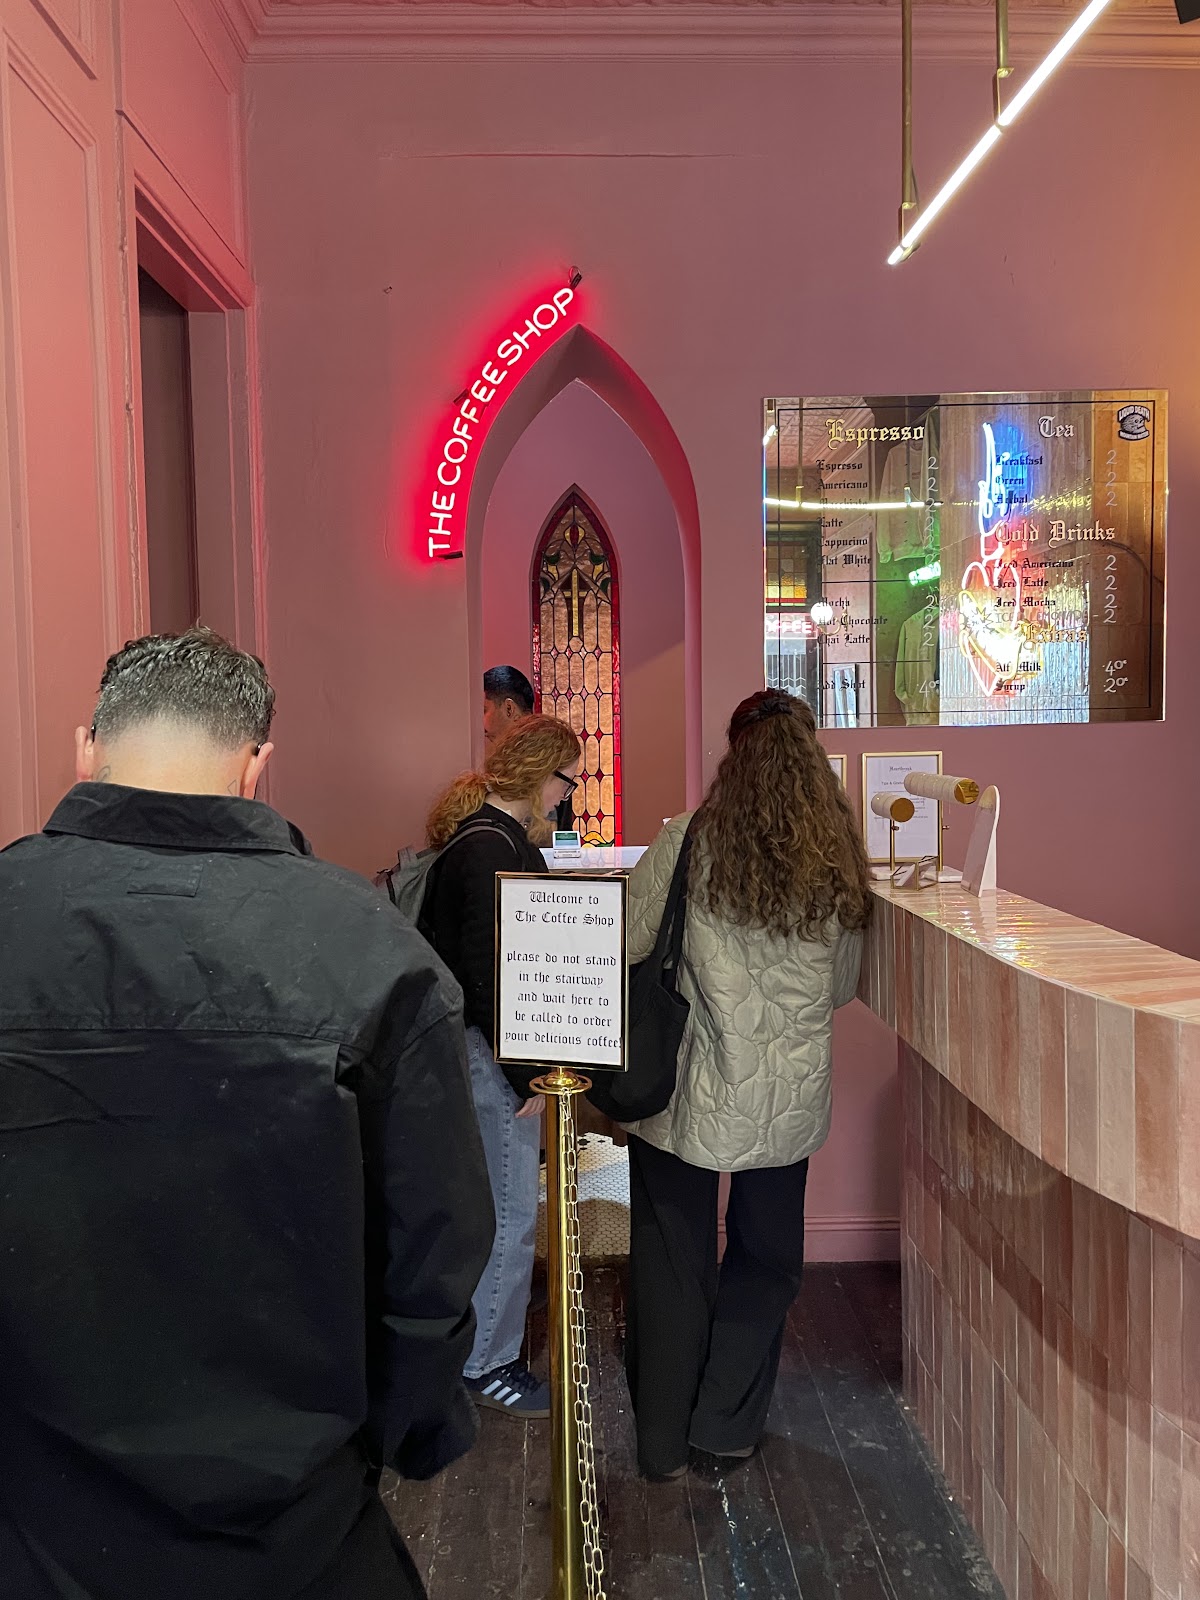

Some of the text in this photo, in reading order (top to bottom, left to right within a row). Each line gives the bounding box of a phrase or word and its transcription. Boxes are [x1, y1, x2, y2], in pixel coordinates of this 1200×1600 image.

[428, 287, 574, 557] THE COFFEE SHOP
[1038, 415, 1075, 438] Tea
[825, 418, 925, 450] Espresso
[816, 459, 863, 472] Espresso
[1105, 450, 1118, 465] 2
[816, 479, 868, 493] Americano
[1105, 471, 1117, 487] 2
[1105, 491, 1118, 507] 2
[995, 519, 1116, 549] Cold Drinks
[842, 554, 872, 568] White
[1104, 555, 1118, 571] 2
[1104, 575, 1118, 591] 2
[1022, 597, 1056, 609] Mocha
[1104, 593, 1118, 609] 2
[1103, 608, 1117, 624] 2
[844, 633, 870, 648] Latte
[1022, 623, 1088, 650] Extras
[529, 891, 600, 905] Welcome to
[515, 910, 615, 927] The Coffee Shop
[507, 950, 617, 966] please do not stand
[519, 971, 604, 988] in the stairway
[517, 992, 609, 1007] and wait here to
[515, 1010, 612, 1027] be called to order
[504, 1031, 529, 1043] your
[534, 1032, 582, 1045] delicious
